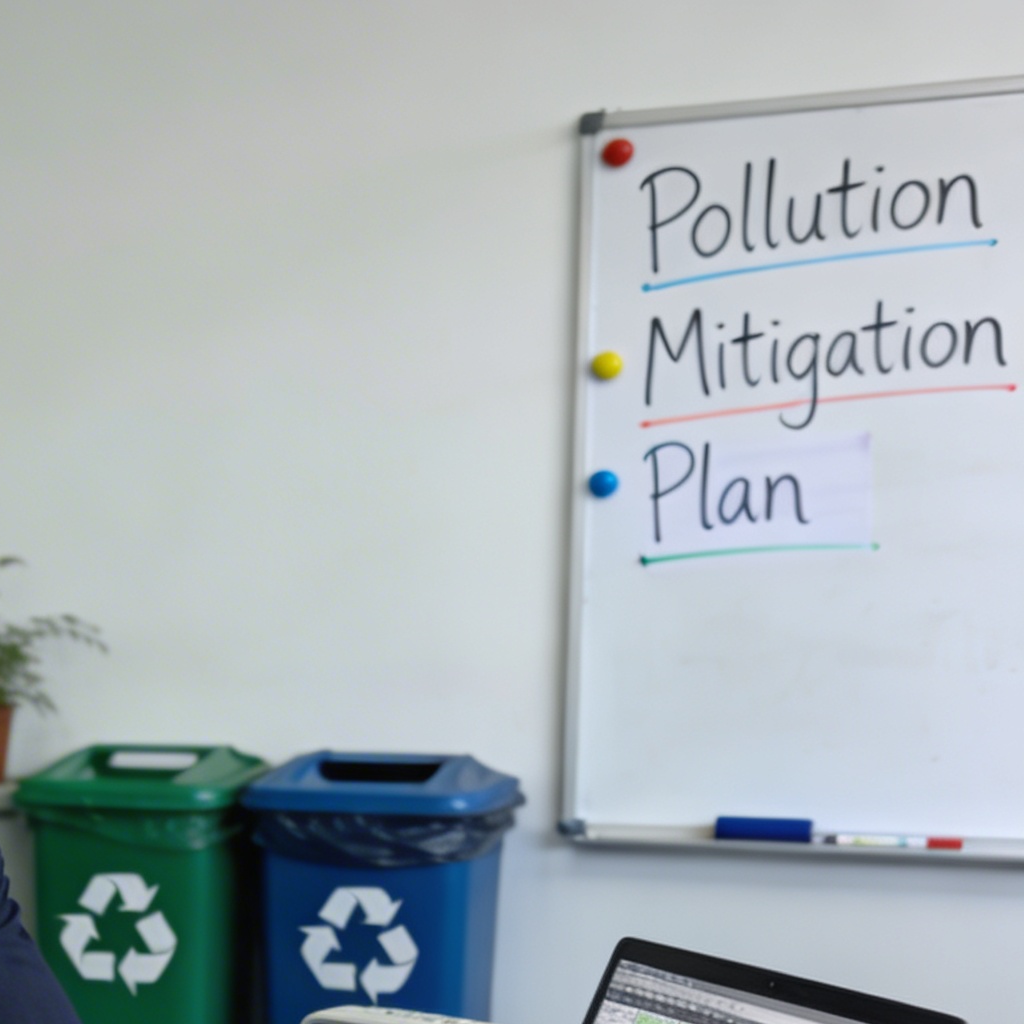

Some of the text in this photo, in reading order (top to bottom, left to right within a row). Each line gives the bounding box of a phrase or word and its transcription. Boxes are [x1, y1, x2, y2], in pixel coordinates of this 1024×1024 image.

[640, 158, 983, 273] Pollution
[645, 300, 1007, 430] Mitigation
[643, 442, 810, 543] Plan
